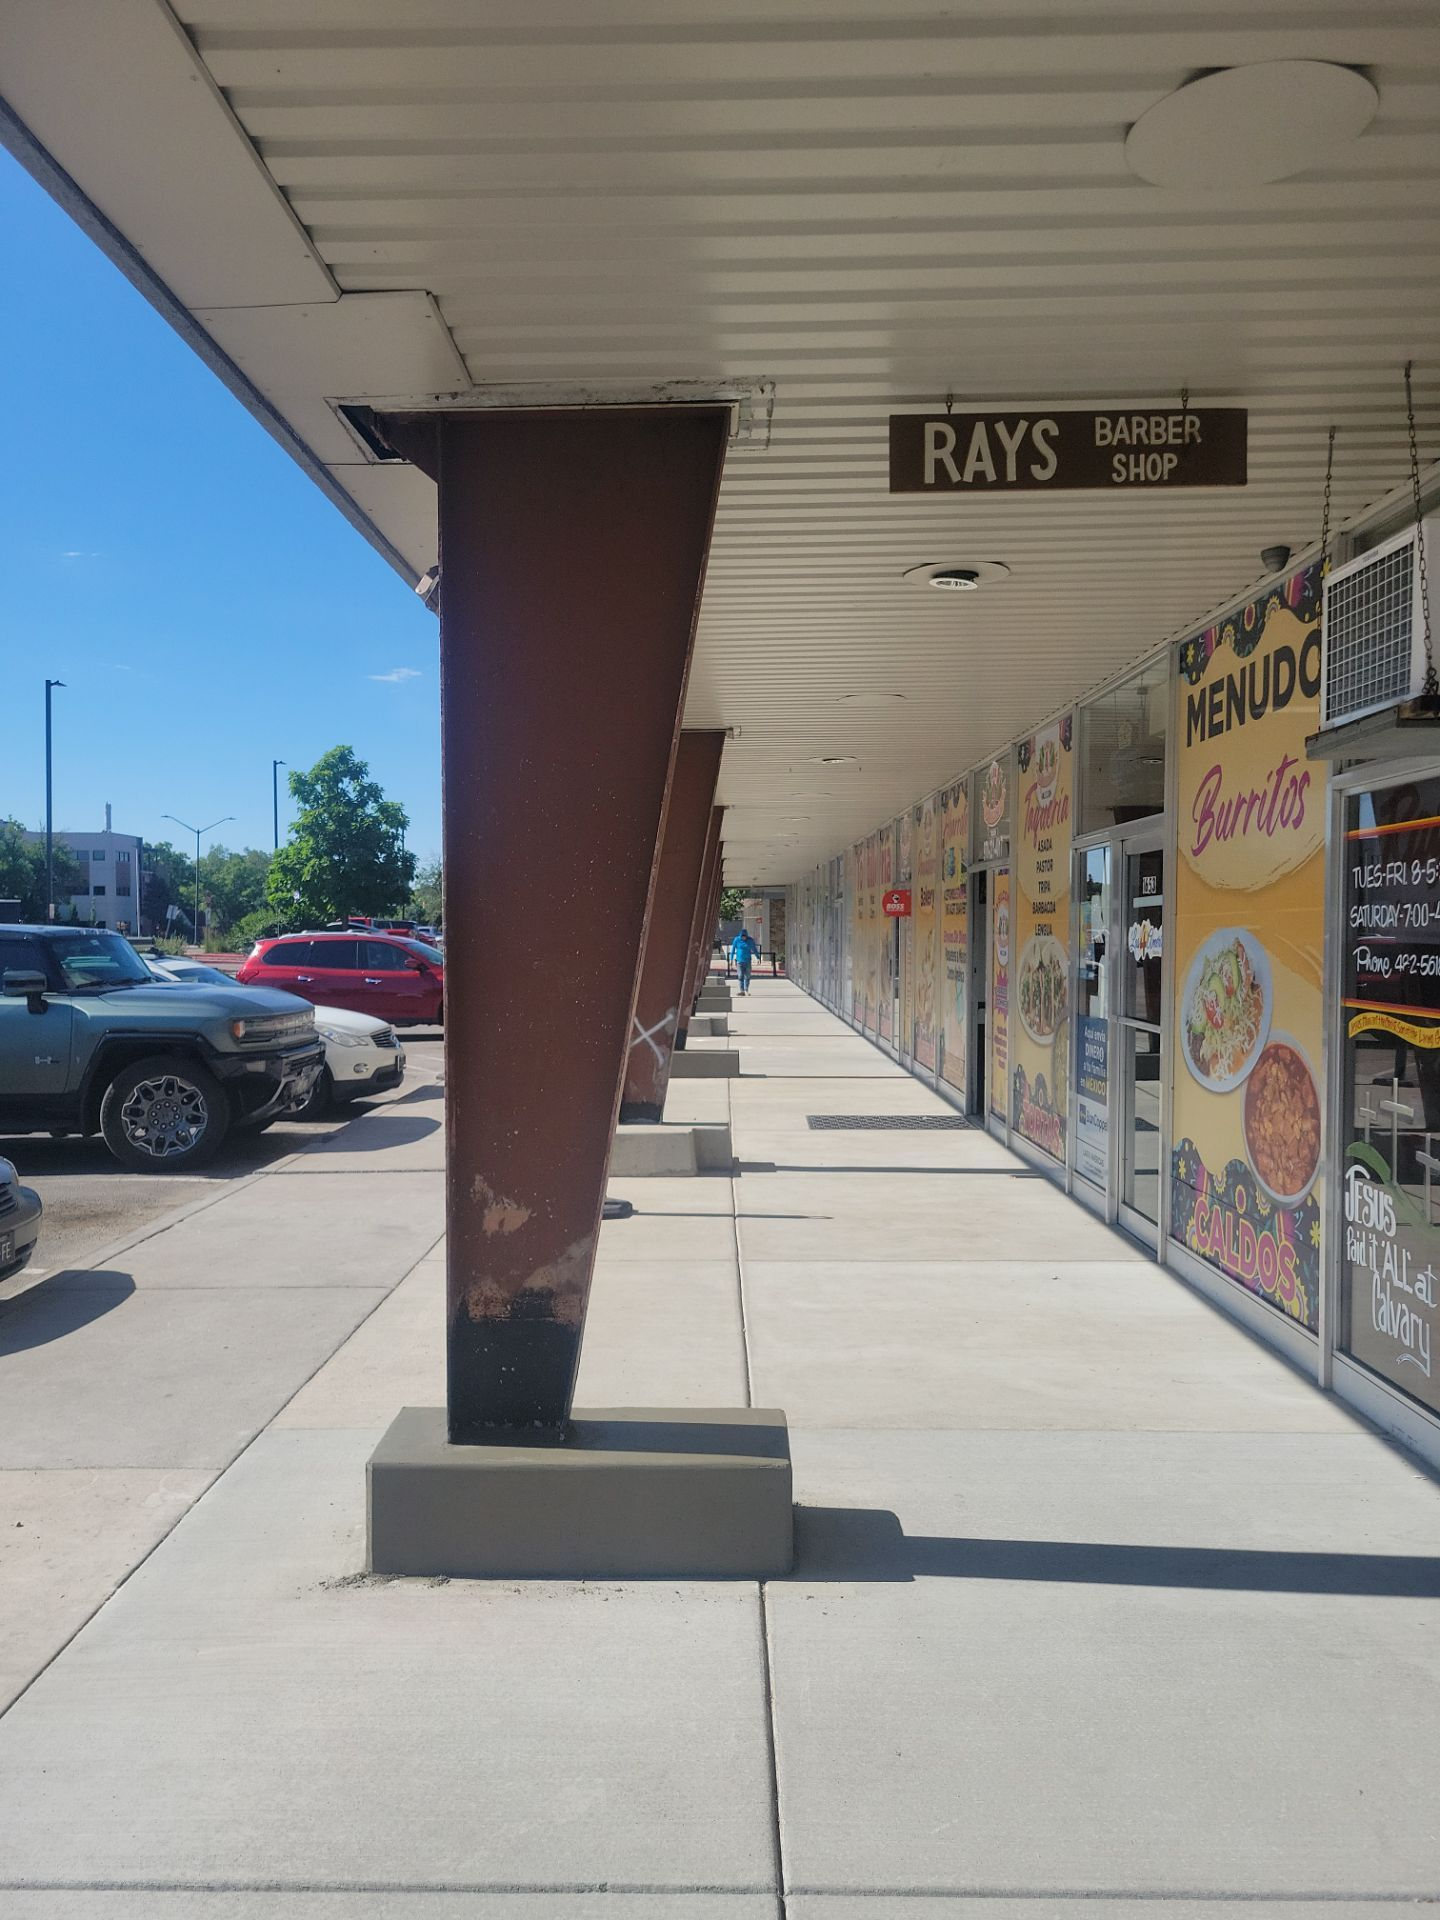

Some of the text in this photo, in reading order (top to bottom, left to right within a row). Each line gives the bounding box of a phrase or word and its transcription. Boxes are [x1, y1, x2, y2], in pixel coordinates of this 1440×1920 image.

[1095, 415, 1202, 447] BARBER
[924, 419, 1060, 484] RAYS
[1112, 453, 1178, 483] SHOP
[1186, 628, 1321, 748] MENUDO
[1191, 753, 1310, 857] Burritos
[1038, 837, 1052, 852] ASADA
[1036, 858, 1053, 874] PASTOR
[1411, 857, 1440, 886] 8-5:
[1038, 881, 1051, 894] TRIPA
[1032, 901, 1056, 915] BARBACOA
[1035, 923, 1052, 937] LENGUA
[1352, 946, 1392, 979] Phone
[1345, 1164, 1397, 1237] JESUS
[1193, 1197, 1297, 1302] CALDOS
[1346, 1226, 1367, 1267] Paid
[1368, 1233, 1380, 1274] it
[1414, 1264, 1438, 1308] at
[1371, 1272, 1430, 1378] Calvary
